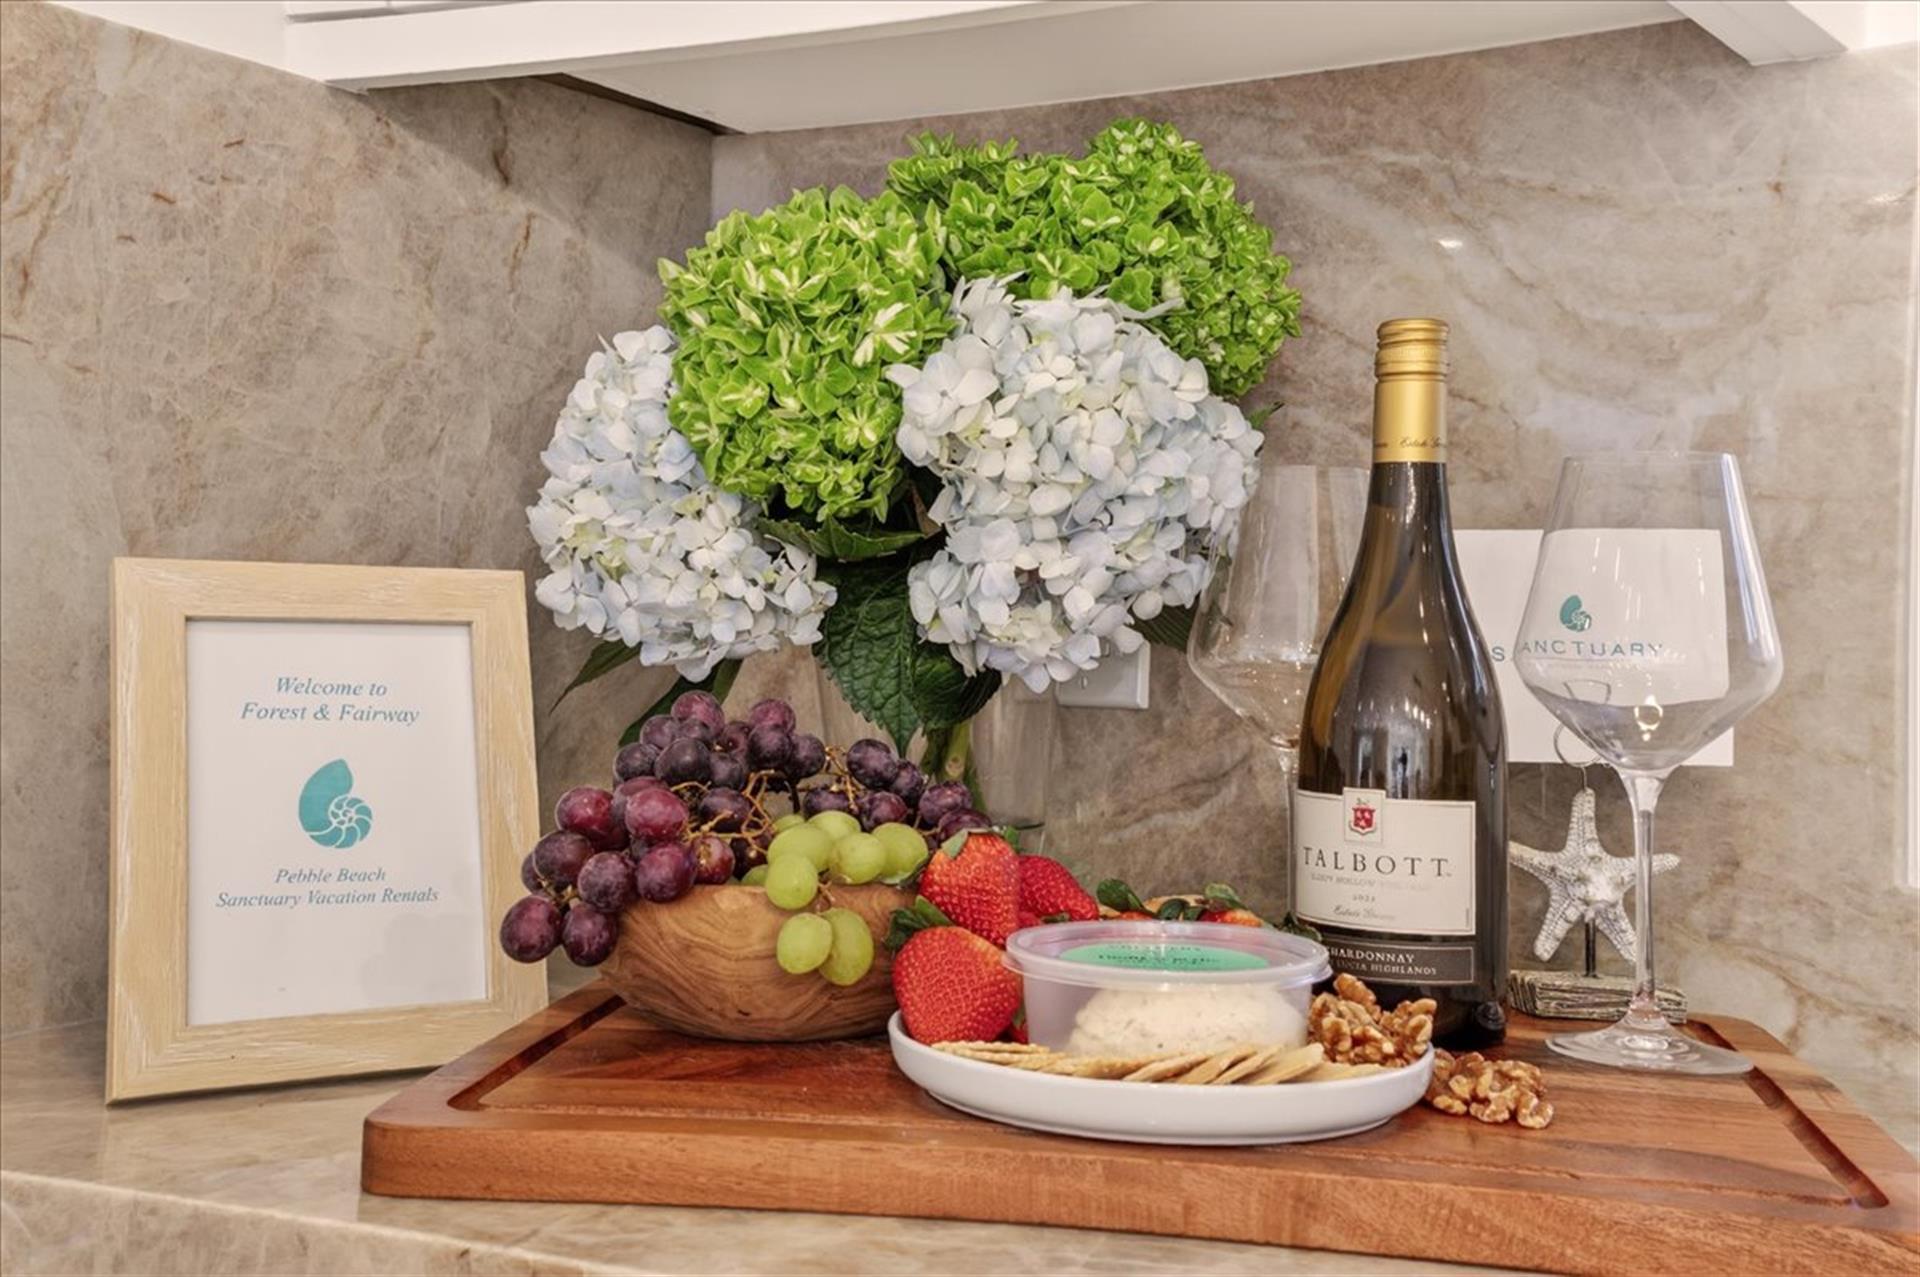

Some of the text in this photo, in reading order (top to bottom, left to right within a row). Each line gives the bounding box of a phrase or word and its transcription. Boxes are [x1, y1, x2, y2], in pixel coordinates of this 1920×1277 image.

[1490, 639, 1664, 663] SANCTUARY
[275, 676, 388, 697] Welcome to
[240, 701, 421, 727] Forest & Fairway
[1303, 846, 1449, 878] TALBOTT
[274, 867, 387, 884] Pebble Beach
[215, 886, 440, 909] Sanctuary Vacation Rentals
